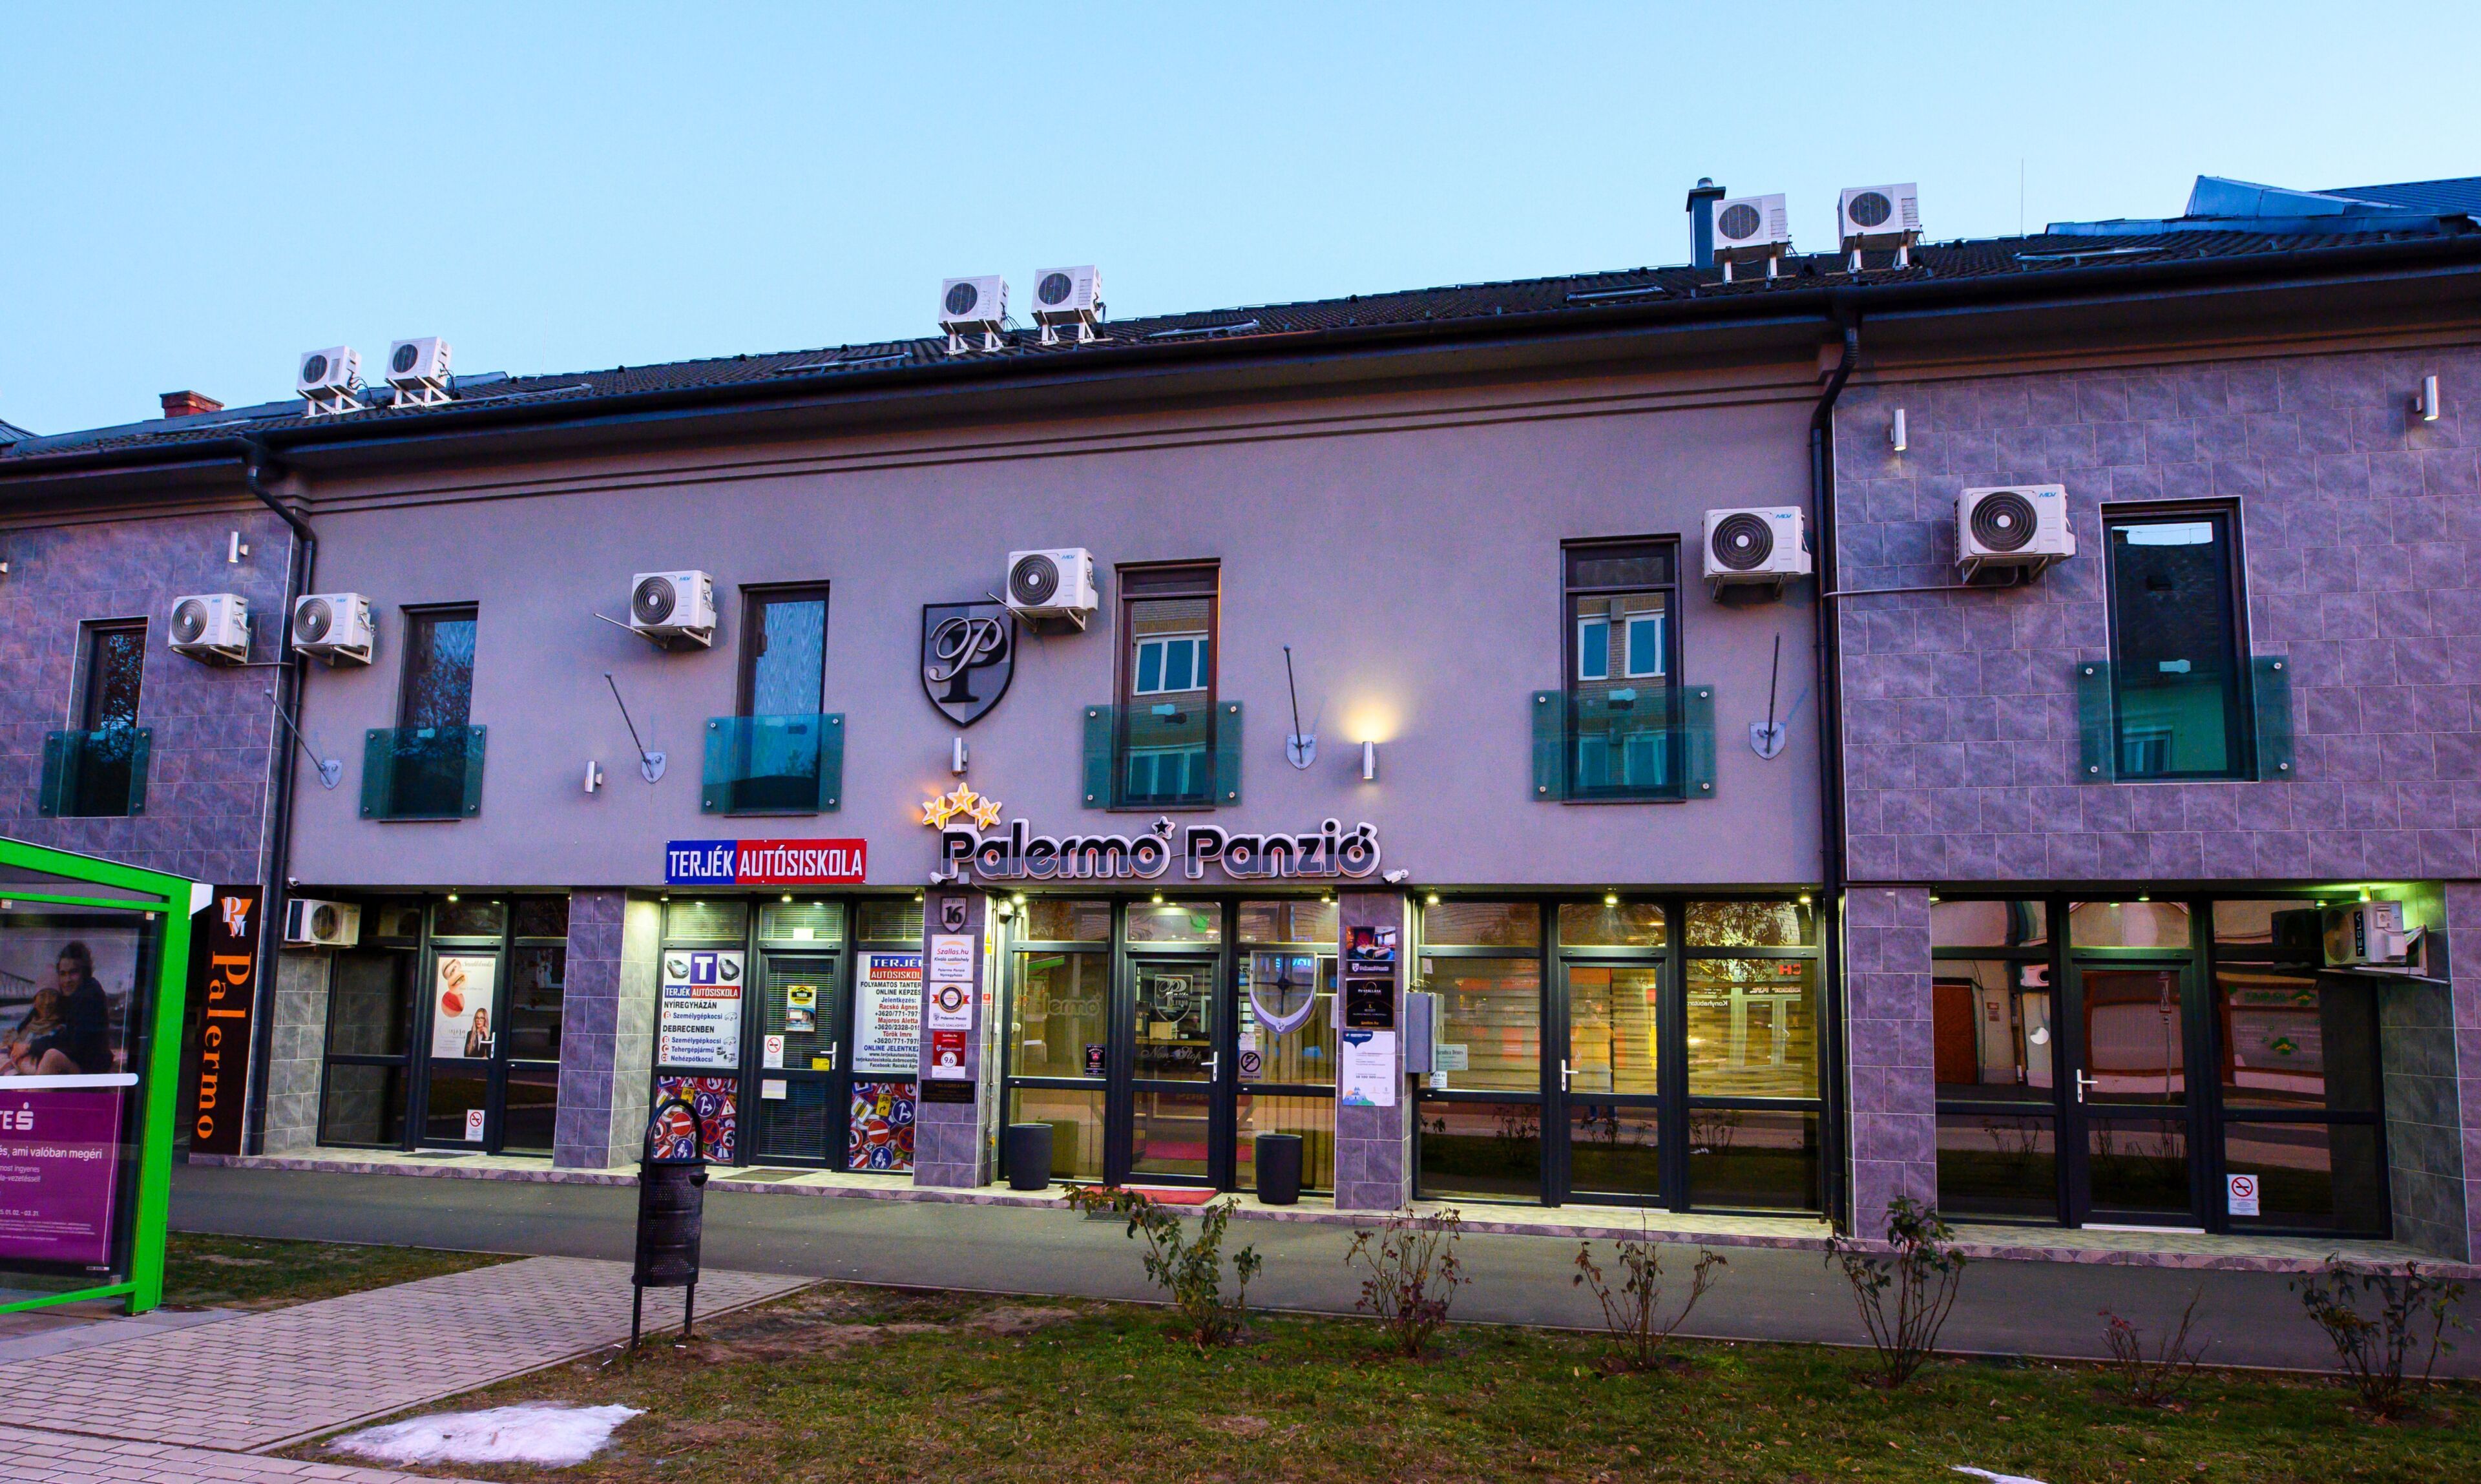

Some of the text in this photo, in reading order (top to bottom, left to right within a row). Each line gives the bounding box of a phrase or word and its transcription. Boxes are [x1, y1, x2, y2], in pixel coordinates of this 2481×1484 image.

[941, 817, 1383, 879] Palermo Panzió
[669, 844, 863, 877] TERJÉK AUTÓSISKOLA
[945, 906, 963, 924] 16
[695, 956, 713, 980] T
[665, 987, 738, 997] TERJÉK AUTÓSISKOLA
[664, 999, 717, 1008] NYÍREGYHÁZÁN
[197, 951, 252, 1139] Palermo
[1140, 1045, 1203, 1064] Non-Stop
[12, 1146, 28, 1157] ami
[30, 1147, 67, 1158] valóban
[68, 1148, 103, 1162] megéri
[14, 1165, 41, 1174] ingyenes
